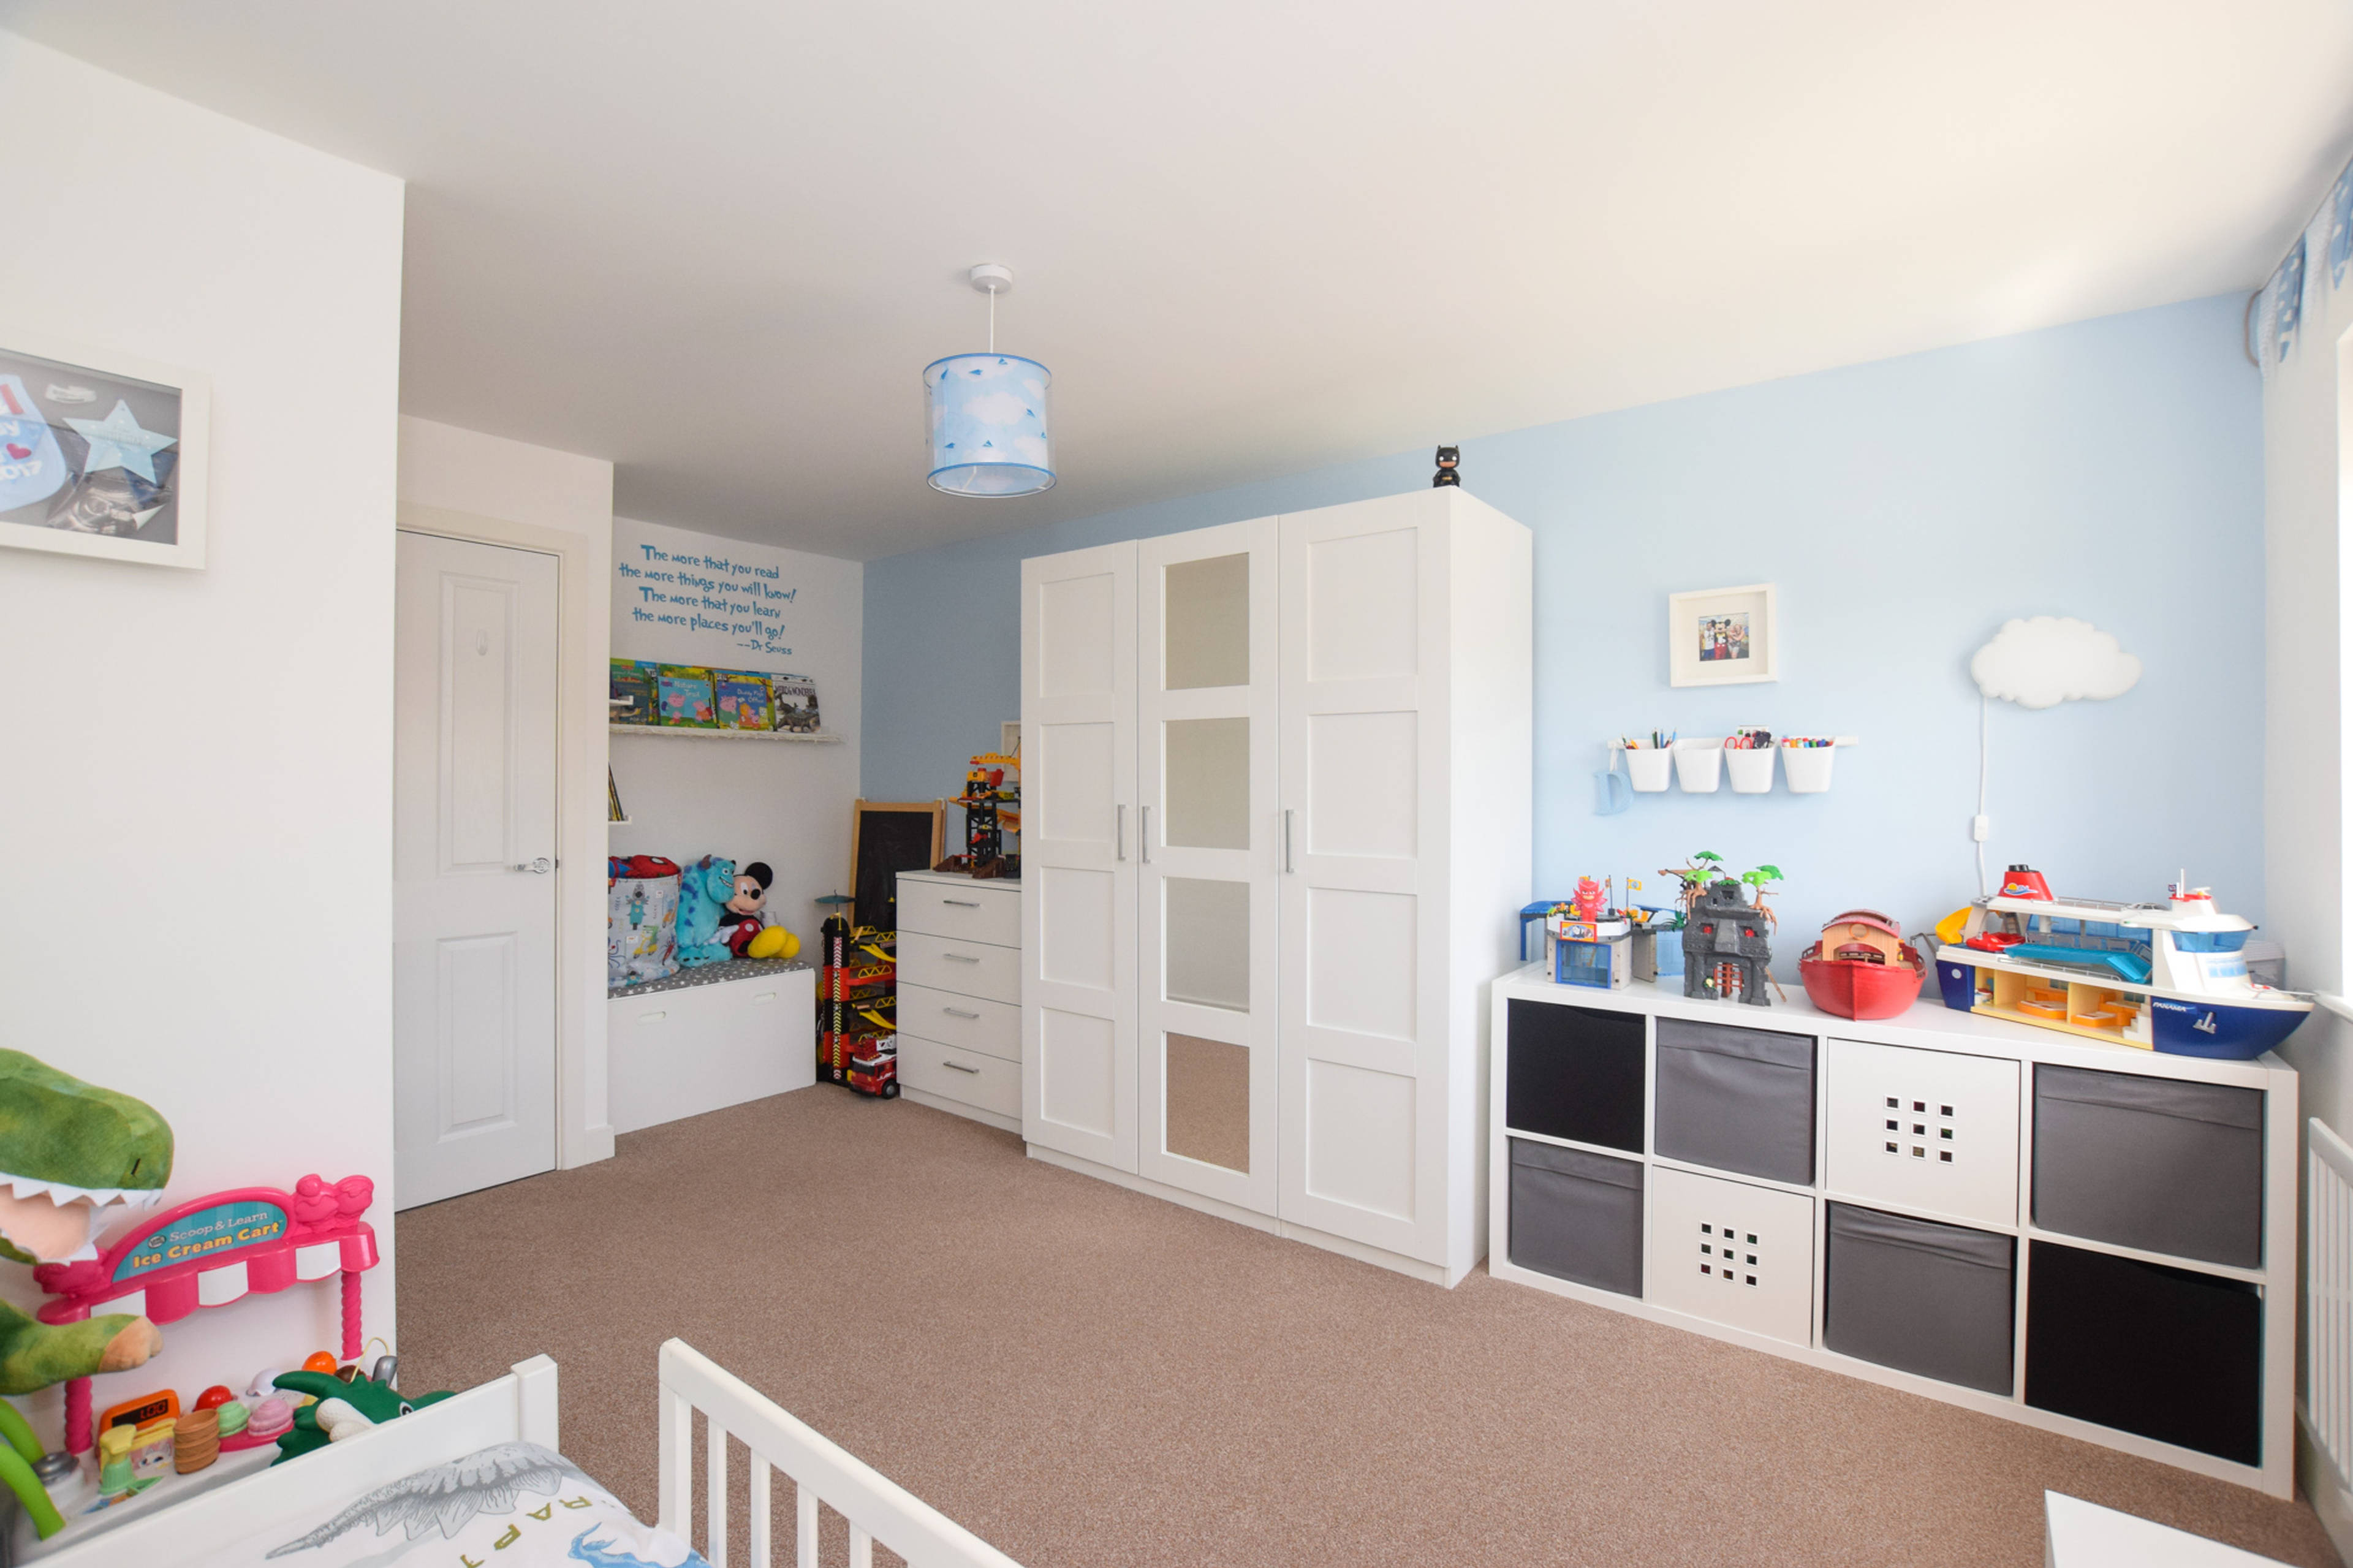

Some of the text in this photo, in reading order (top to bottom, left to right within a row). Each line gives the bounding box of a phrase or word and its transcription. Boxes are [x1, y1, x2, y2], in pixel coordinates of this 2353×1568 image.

[640, 544, 779, 578] The more that you read
[619, 562, 797, 603] the more things you will know!
[638, 586, 781, 619] The more that you learn
[632, 607, 785, 640] the more places you'll go!
[765, 642, 792, 655] Seuss
[2153, 1001, 2187, 1012] PANAMA
[169, 1225, 213, 1242] Scoop
[214, 1221, 225, 1230] &
[227, 1212, 268, 1228] Learn
[132, 1253, 162, 1268] Ice
[167, 1235, 233, 1258] Cream
[237, 1222, 279, 1241] Cart
